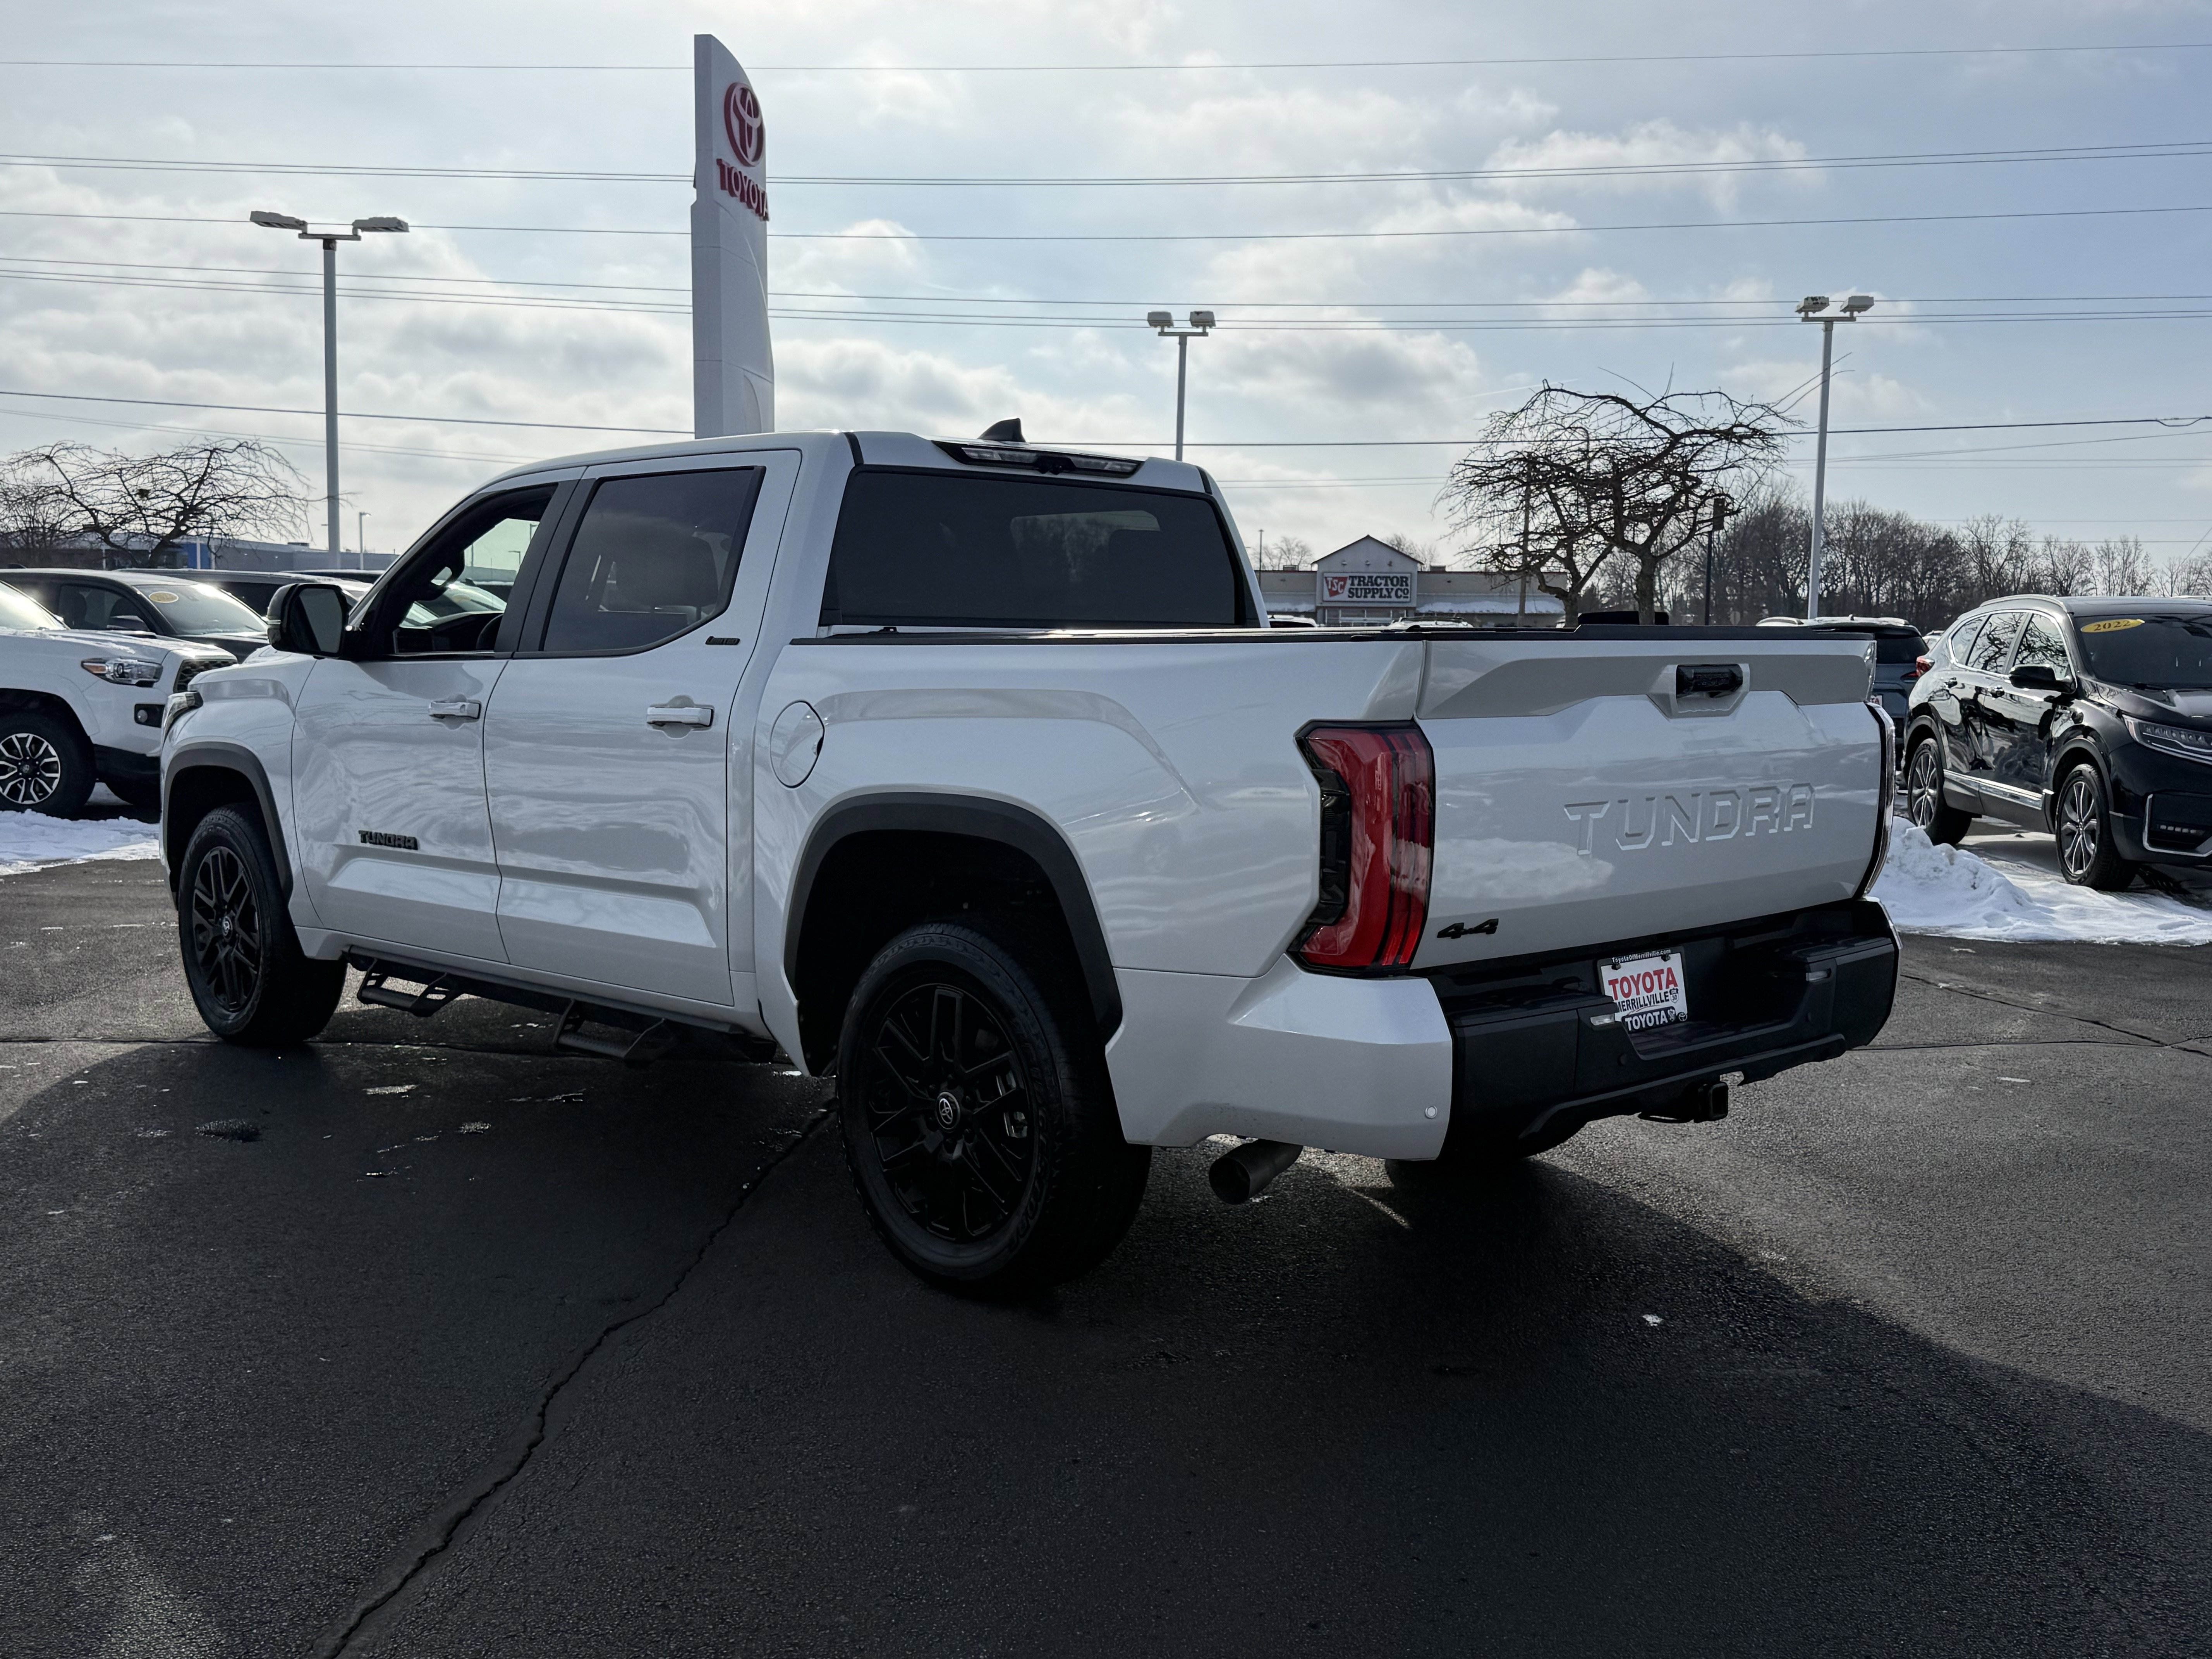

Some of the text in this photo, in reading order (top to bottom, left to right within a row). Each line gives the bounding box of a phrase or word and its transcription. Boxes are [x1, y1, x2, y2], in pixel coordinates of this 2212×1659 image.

[716, 158, 769, 222] TOYOTA
[1327, 577, 1343, 593] TSC
[1348, 575, 1409, 587] TRACTOR
[1348, 587, 1394, 598] SUPPLY
[2094, 620, 2130, 632] 2022
[1564, 783, 1815, 855] TUNDRA
[358, 830, 418, 850] TUNDRA
[1608, 967, 1678, 1000] TOYOTA
[1625, 1010, 1668, 1031] TOYOTA
